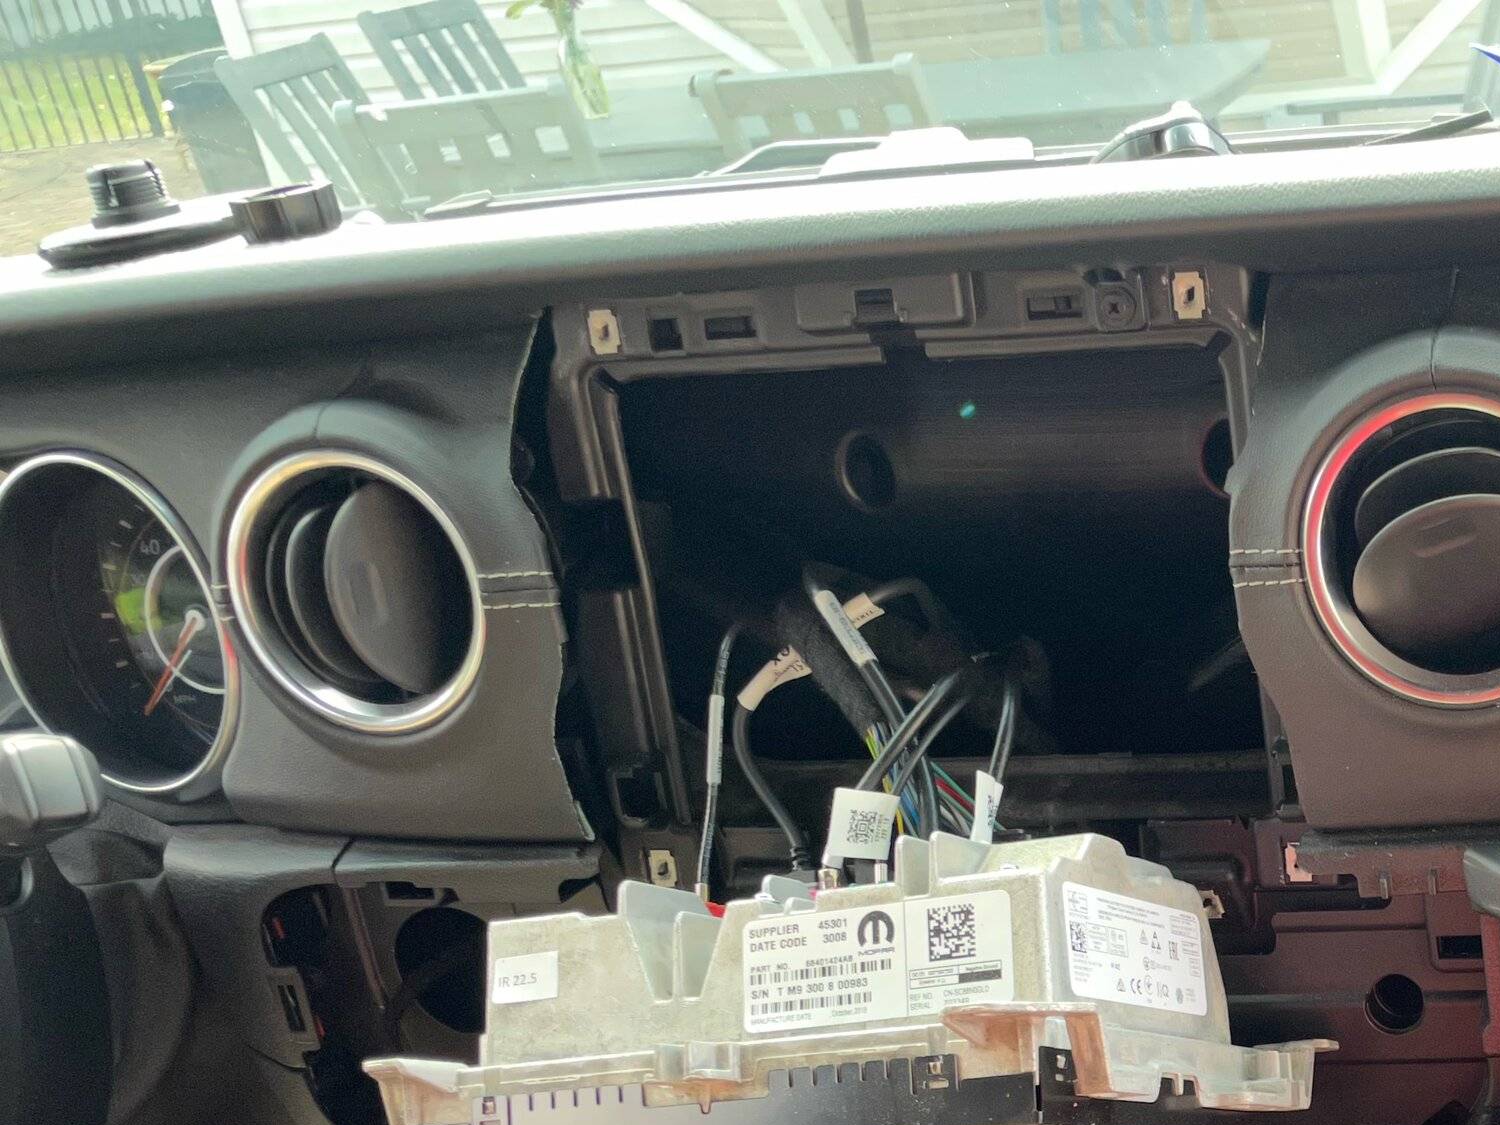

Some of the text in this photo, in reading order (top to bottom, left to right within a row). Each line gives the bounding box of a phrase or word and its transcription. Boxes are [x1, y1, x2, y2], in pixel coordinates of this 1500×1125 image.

[749, 918, 848, 939] SUPPLIER 45301
[750, 932, 847, 953] DATE CODE 3008
[750, 965, 771, 973] PART
[498, 972, 538, 988] IR 22.5
[752, 989, 769, 1000] S/N
[778, 987, 783, 996] T
[806, 982, 824, 993] 300
[828, 982, 834, 991] 8
[838, 978, 868, 990] 00983
